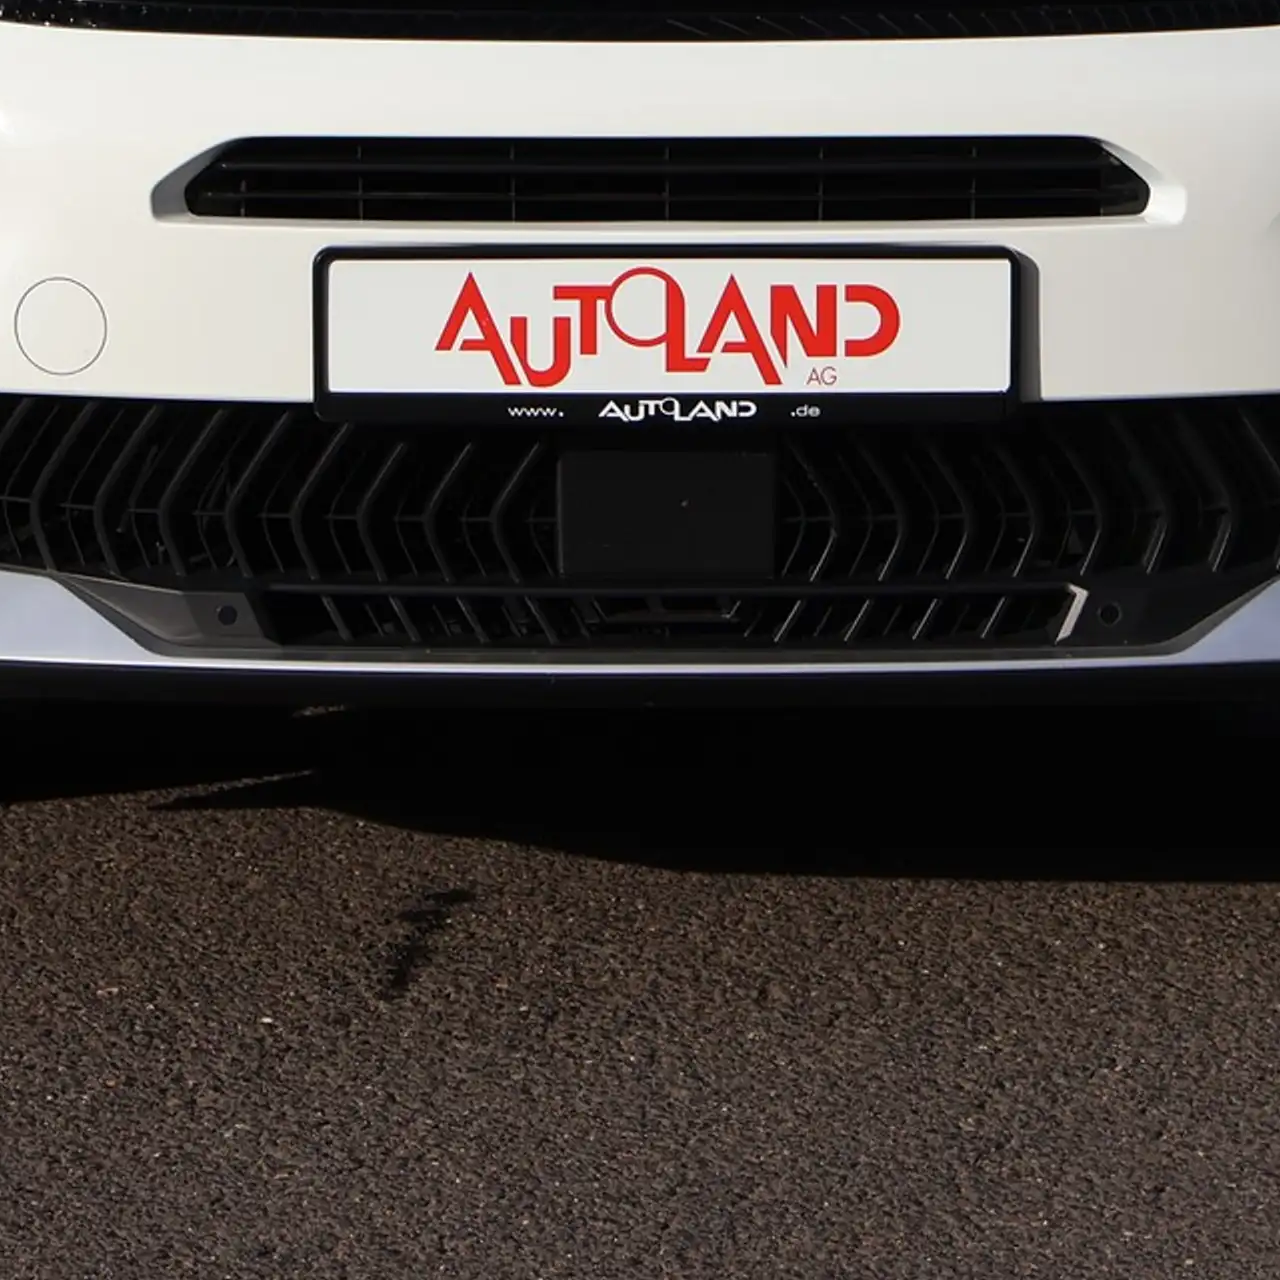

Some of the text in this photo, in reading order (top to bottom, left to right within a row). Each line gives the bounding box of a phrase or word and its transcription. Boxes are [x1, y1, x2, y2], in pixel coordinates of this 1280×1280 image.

[435, 266, 901, 388] AUTOLAND
[806, 366, 838, 386] AG
[597, 396, 758, 422] AUTOLAND
